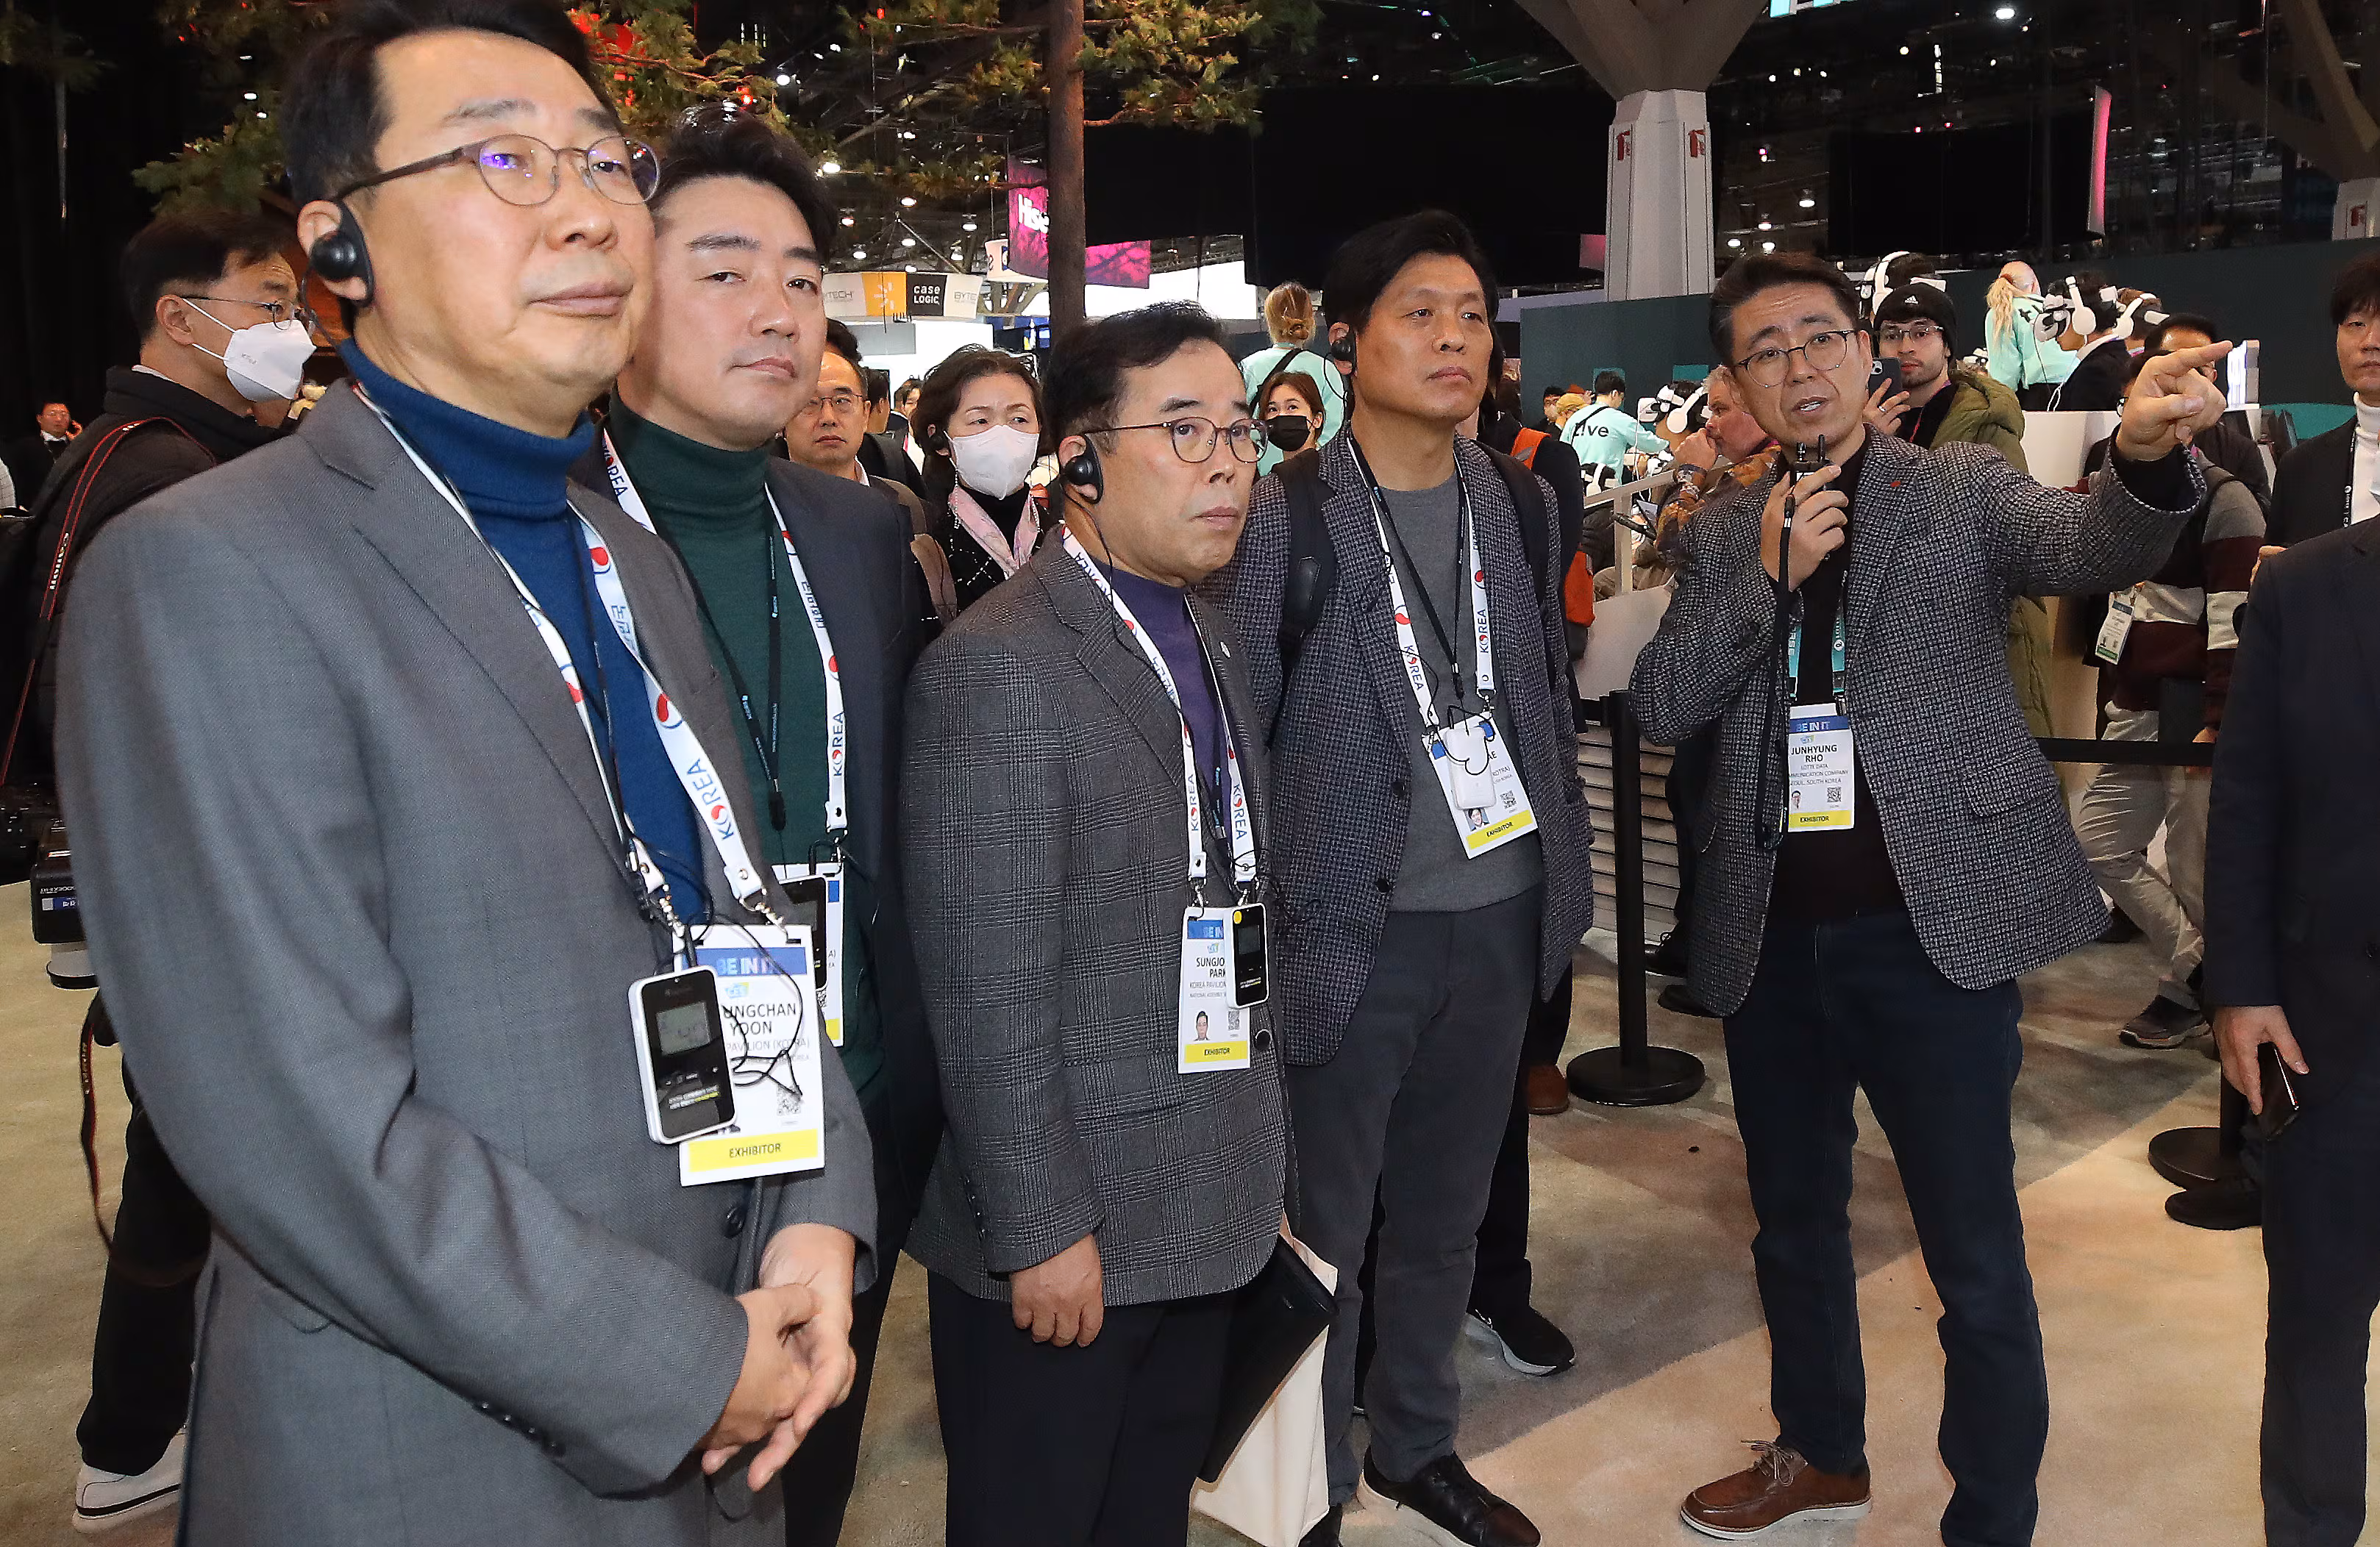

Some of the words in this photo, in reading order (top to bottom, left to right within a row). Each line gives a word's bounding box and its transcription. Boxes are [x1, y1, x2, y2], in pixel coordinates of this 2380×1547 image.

[913, 285, 941, 294] case
[913, 295, 940, 305] LOGIC
[1477, 609, 1489, 654] KOREA
[1403, 644, 1425, 691] KOREA
[833, 710, 845, 776] KOREA
[1791, 744, 1837, 755] JUNHYUNG
[1806, 754, 1823, 762] RHO
[687, 758, 735, 840] KOREA
[1188, 774, 1199, 831] KOREA
[1233, 784, 1247, 840] KOREA
[729, 1020, 772, 1036] YOON
[729, 1143, 782, 1159] EXHIBITOR
